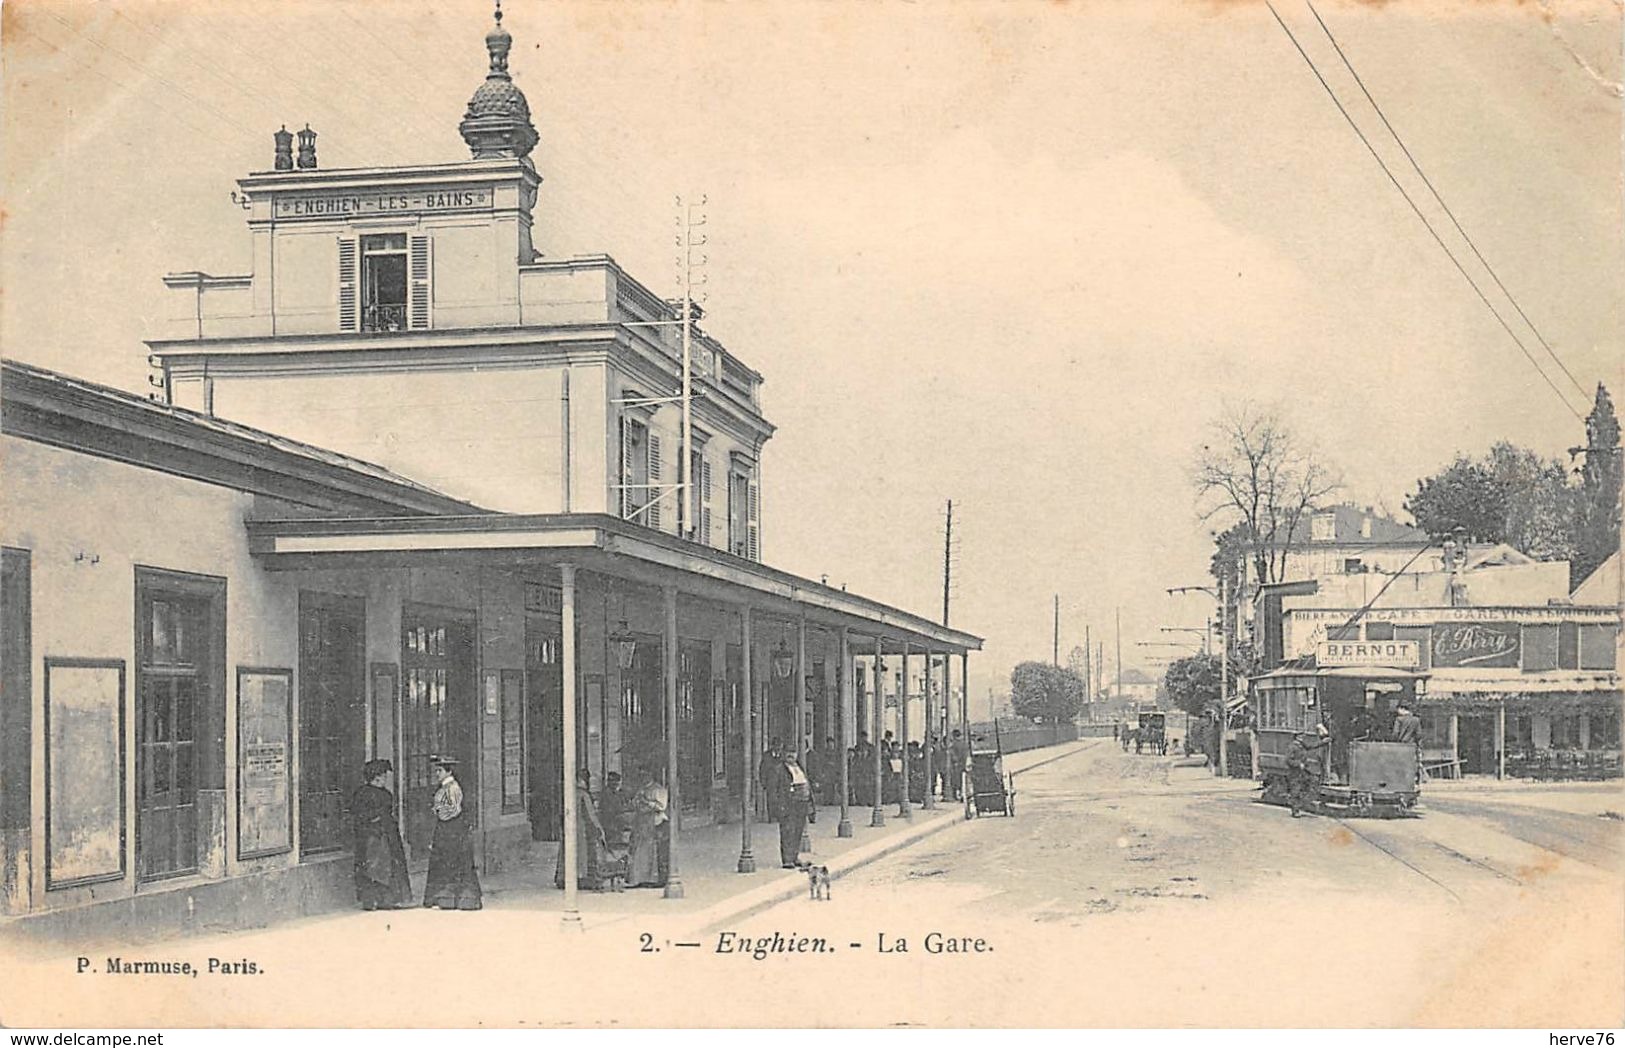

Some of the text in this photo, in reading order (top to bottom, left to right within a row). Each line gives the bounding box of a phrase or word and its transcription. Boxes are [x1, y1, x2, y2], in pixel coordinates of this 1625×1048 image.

[294, 197, 361, 214] ENGHIEN
[378, 195, 408, 210] LES
[426, 191, 473, 209] BAINS
[1328, 644, 1409, 656] BERNOT
